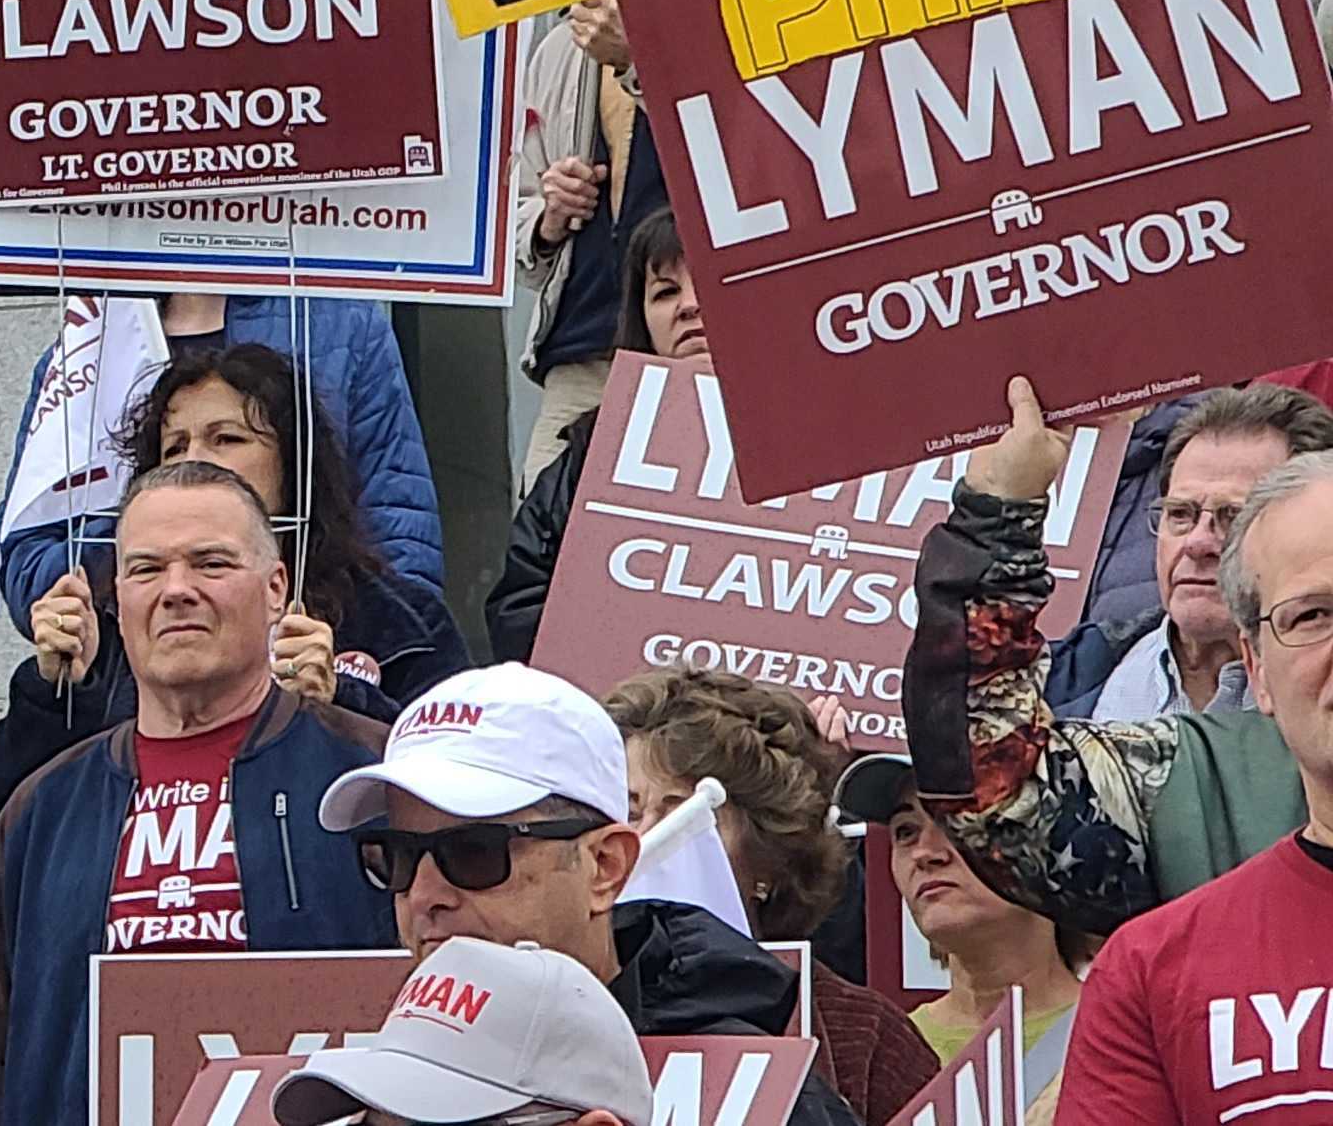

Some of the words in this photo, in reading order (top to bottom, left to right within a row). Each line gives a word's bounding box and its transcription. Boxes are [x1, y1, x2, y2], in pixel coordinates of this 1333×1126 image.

[9, 84, 327, 142] GOVERNOR
[41, 153, 89, 182] LT.
[93, 141, 299, 178] GOVERNOR
[814, 197, 1245, 356] GOVERNOR
[925, 435, 953, 453] Utah
[134, 779, 211, 812] Write
